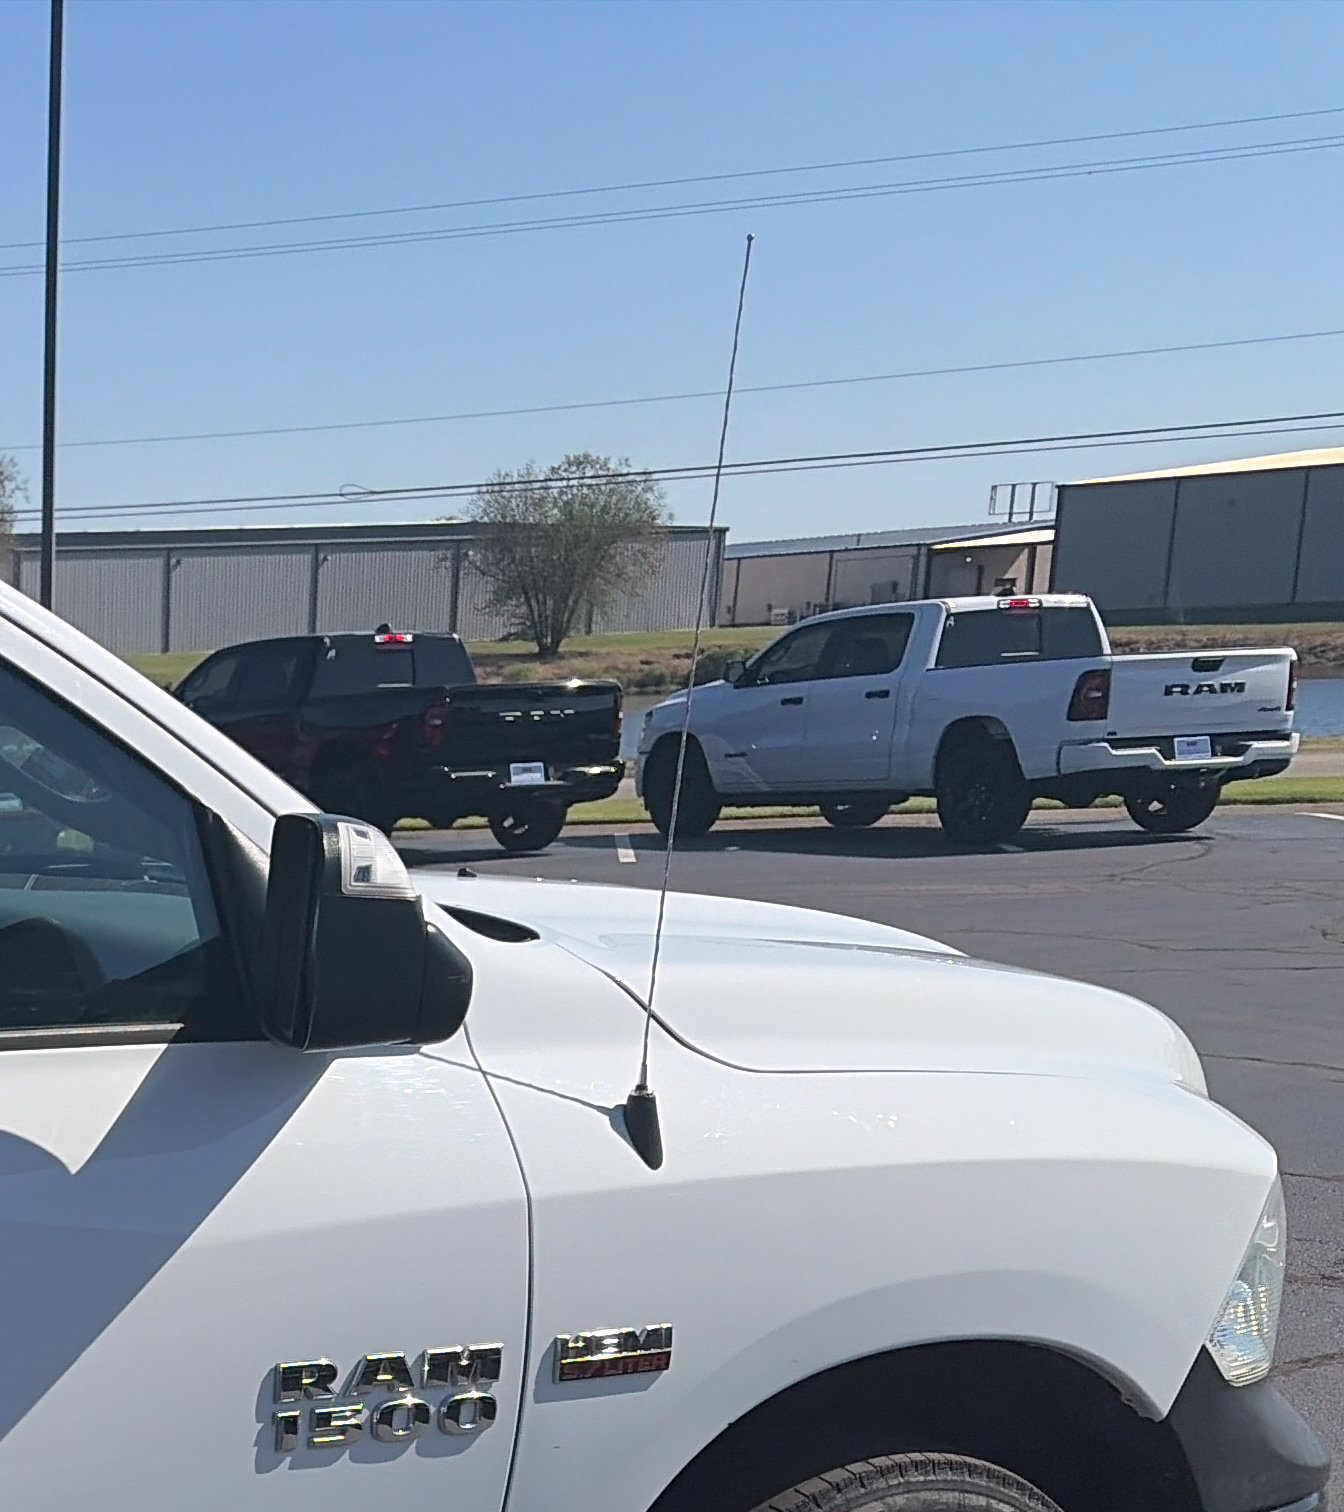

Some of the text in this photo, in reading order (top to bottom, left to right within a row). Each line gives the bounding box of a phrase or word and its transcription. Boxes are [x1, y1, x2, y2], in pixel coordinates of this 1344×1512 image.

[1164, 681, 1247, 697] RAM
[552, 1322, 672, 1362] HEMI
[273, 1341, 504, 1404] RAM
[273, 1391, 498, 1453] 1500
